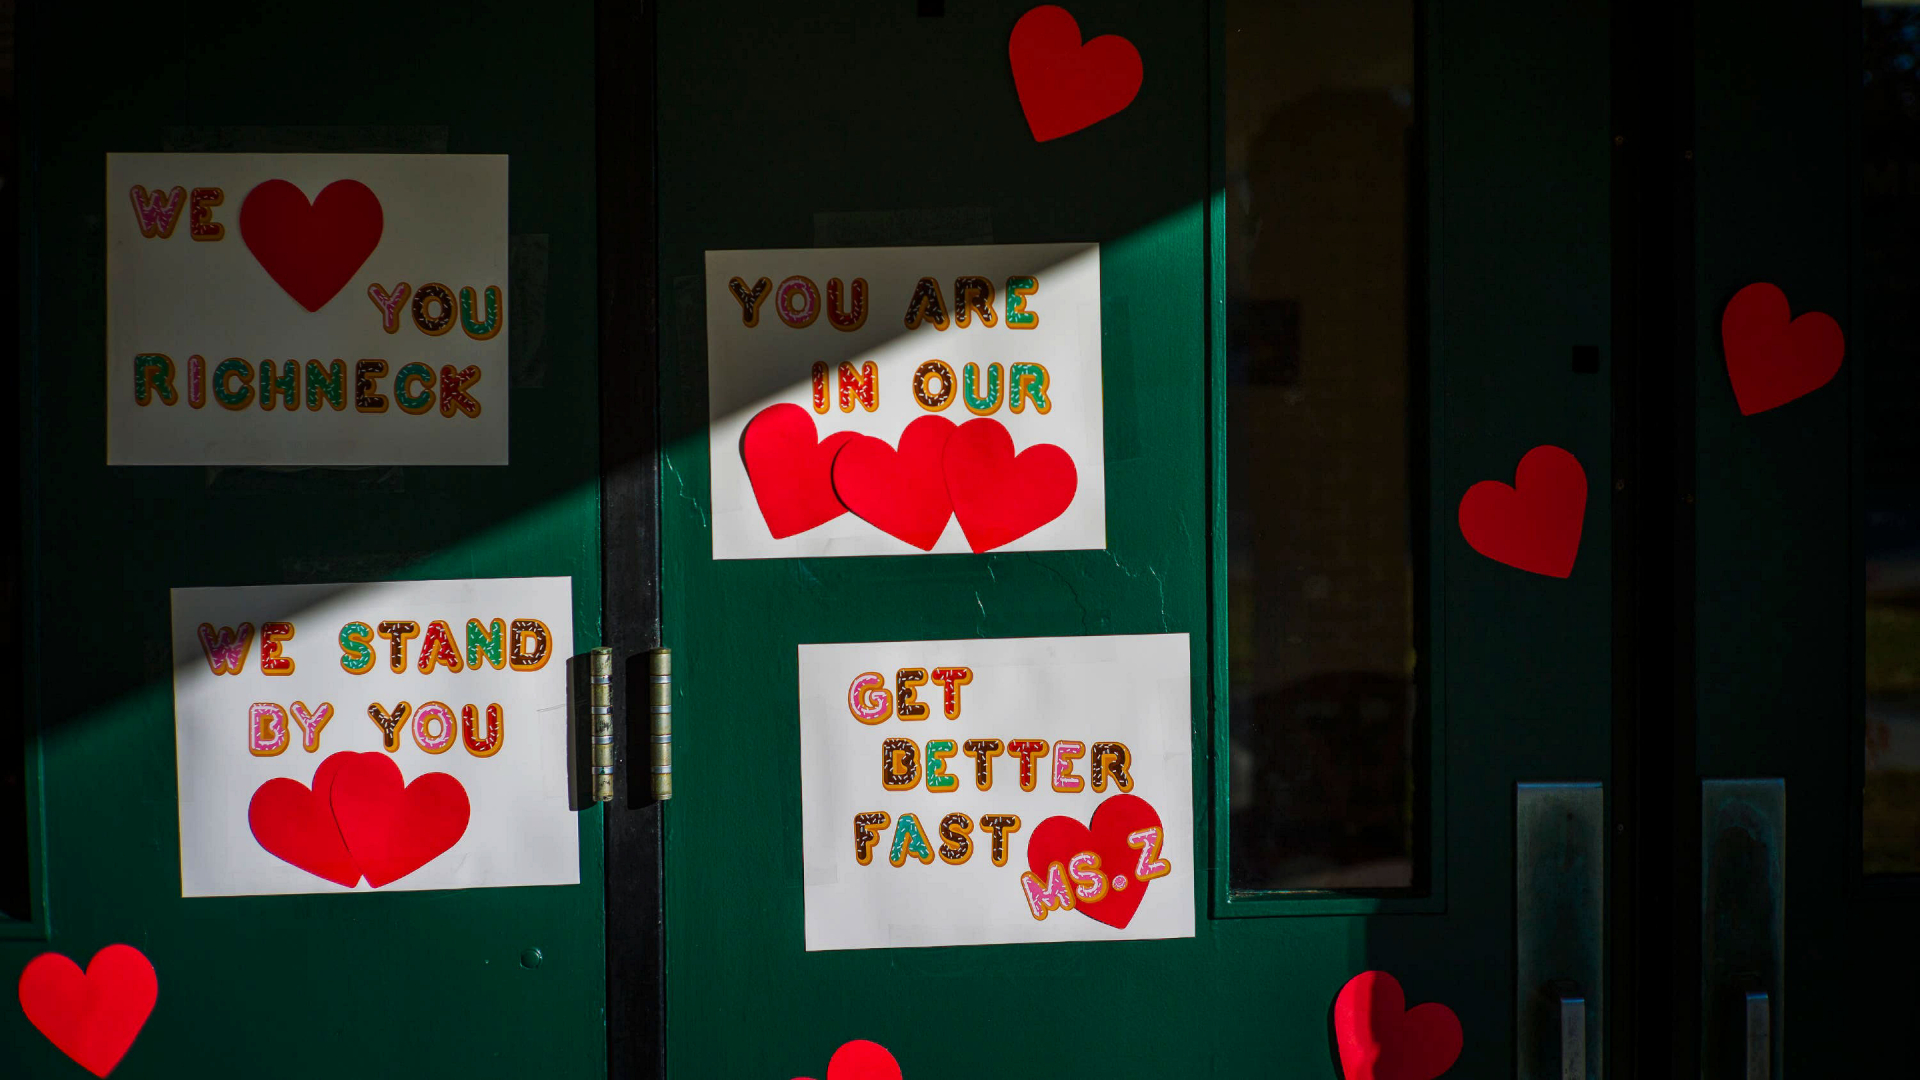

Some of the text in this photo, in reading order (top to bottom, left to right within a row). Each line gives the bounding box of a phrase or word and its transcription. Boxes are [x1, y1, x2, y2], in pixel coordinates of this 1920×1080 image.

[130, 184, 225, 241] WE
[367, 282, 502, 340] YOU
[728, 275, 1039, 332] YOU ARE
[134, 353, 481, 418] RICHNECK
[812, 359, 1052, 416] IN OUR
[197, 617, 552, 676] WE STAND
[848, 667, 973, 725] GET
[248, 701, 504, 758] BY YOU
[882, 738, 1134, 793] BETTER
[854, 811, 1021, 867] FAST
[1020, 826, 1171, 921] MS. Z
